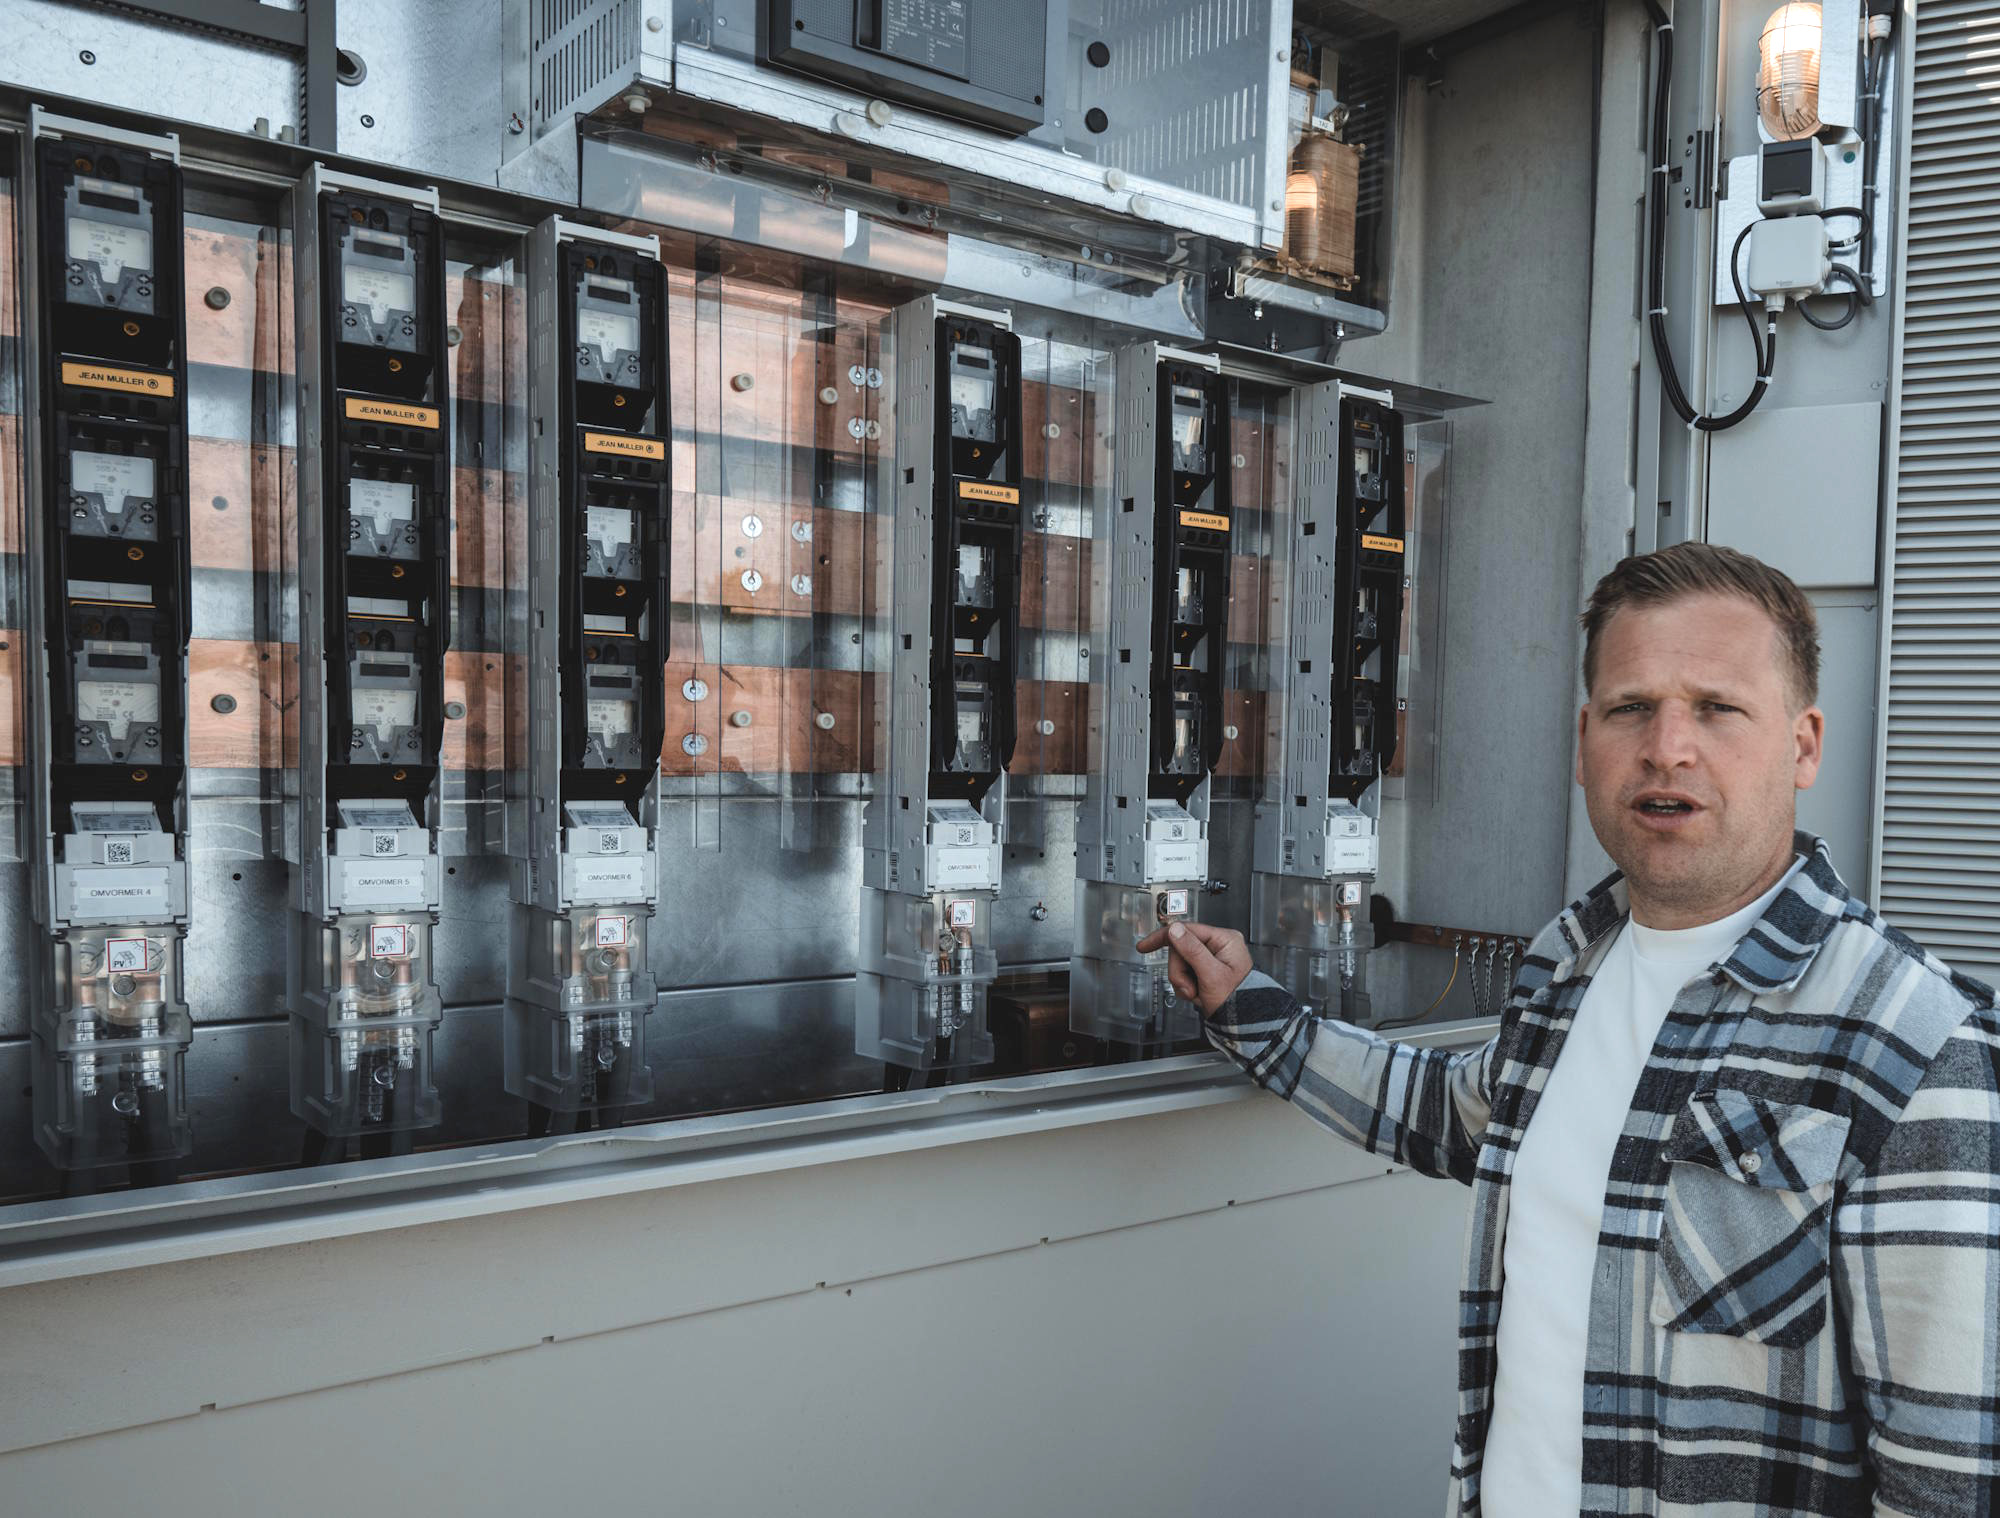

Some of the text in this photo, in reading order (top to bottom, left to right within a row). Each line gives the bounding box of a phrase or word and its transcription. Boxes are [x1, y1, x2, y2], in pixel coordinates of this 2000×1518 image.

[79, 372, 104, 380] JEAN
[360, 406, 381, 414] JEAN
[90, 888, 143, 897] OMVORMER
